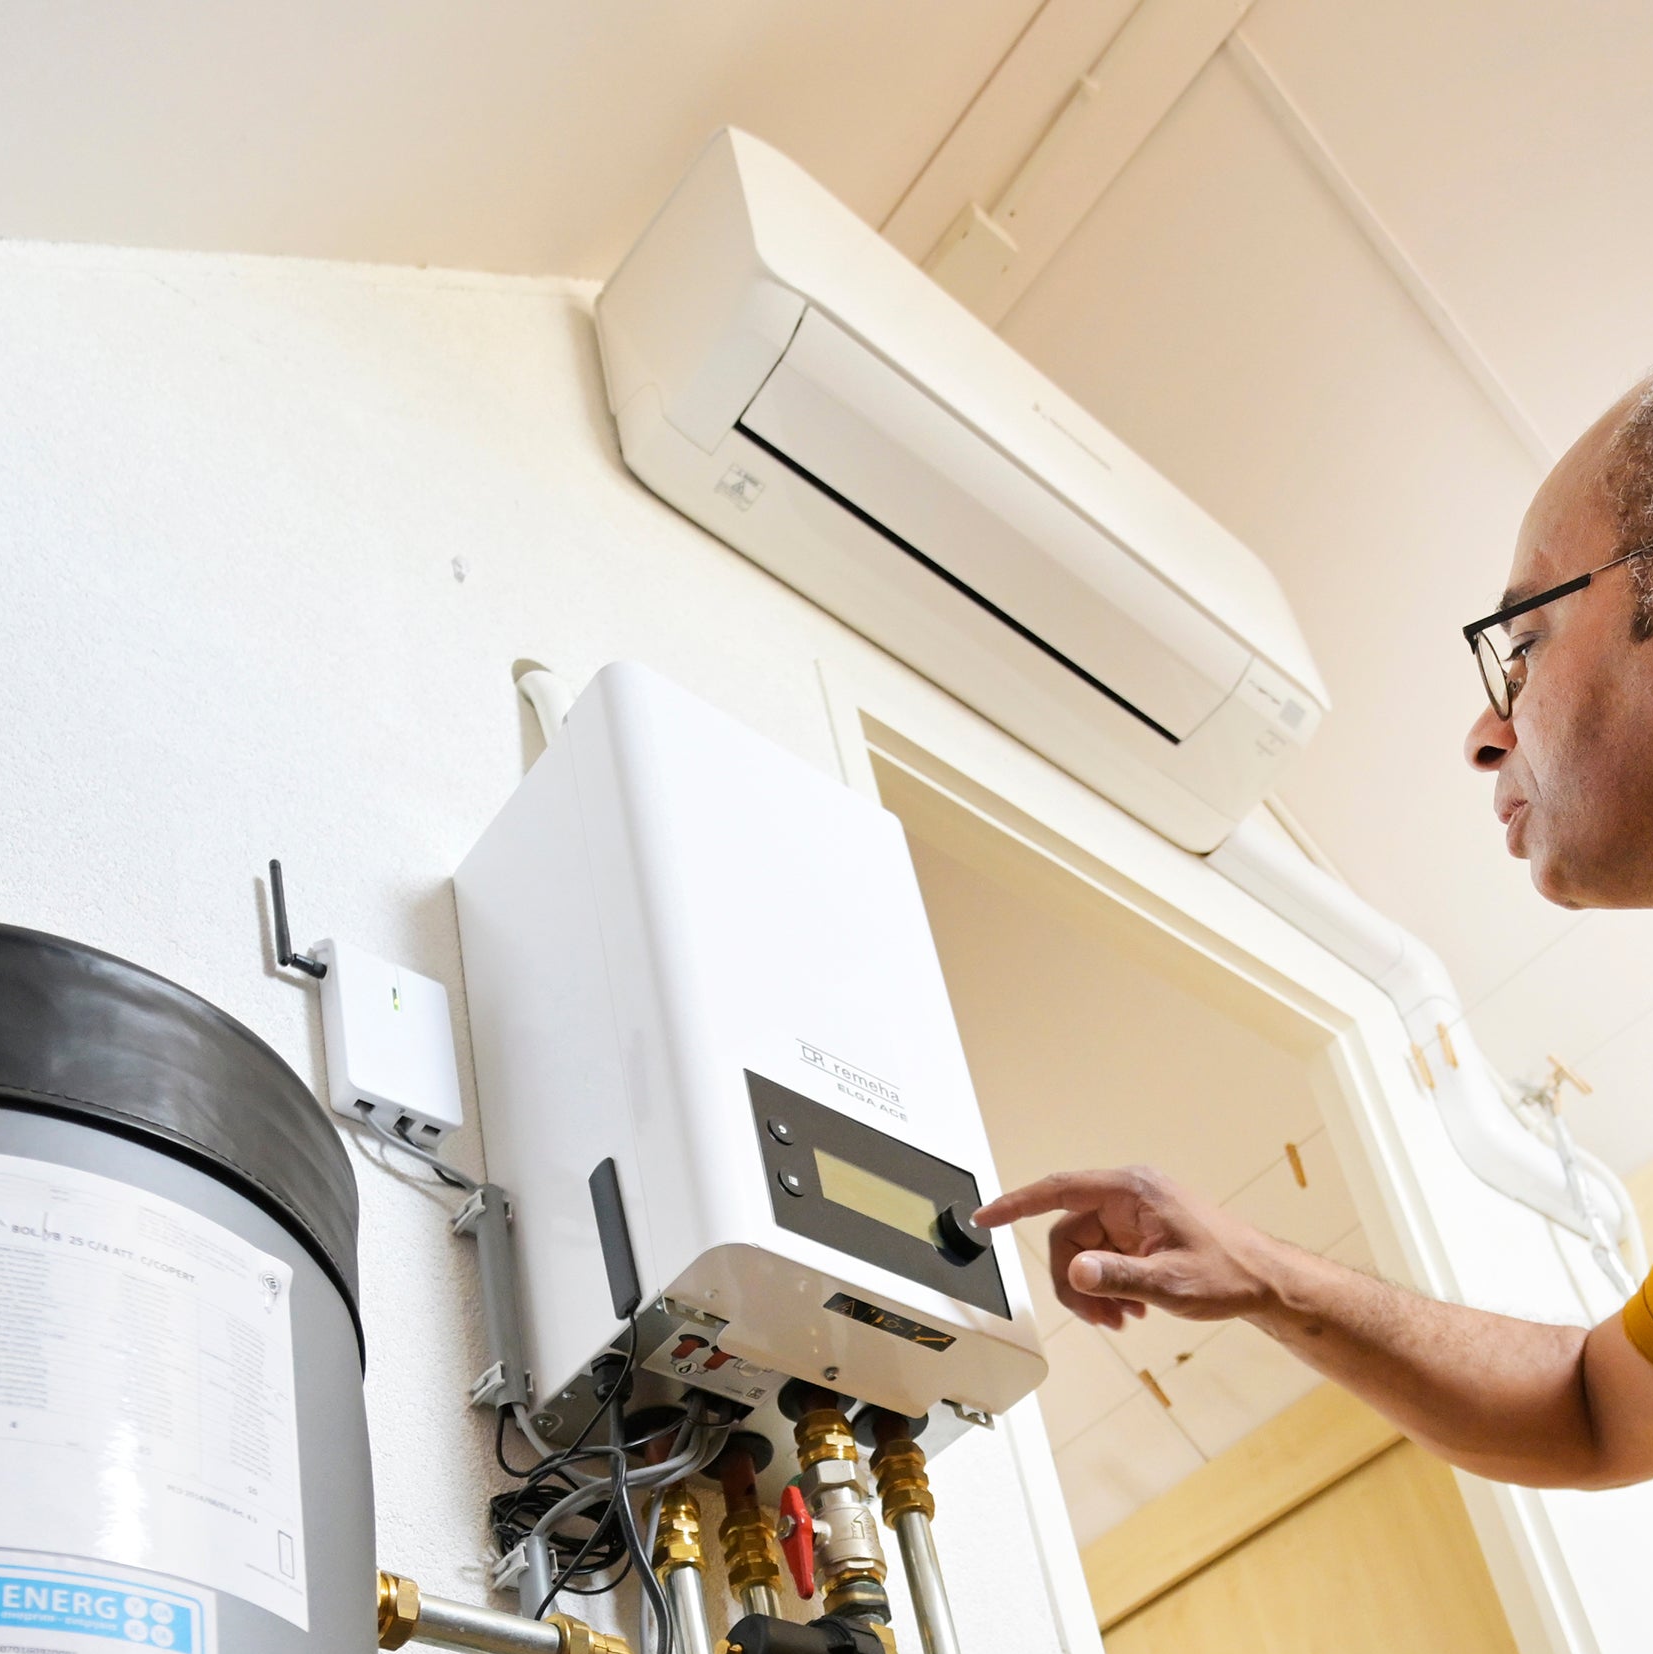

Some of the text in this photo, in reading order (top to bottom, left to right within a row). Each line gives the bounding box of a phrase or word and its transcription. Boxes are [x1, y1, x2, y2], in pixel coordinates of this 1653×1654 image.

[833, 1063, 900, 1103] remeha
[837, 1083, 908, 1122] ELGA ACE
[69, 1235, 84, 1247] 25
[2, 1584, 118, 1620] ENERG
